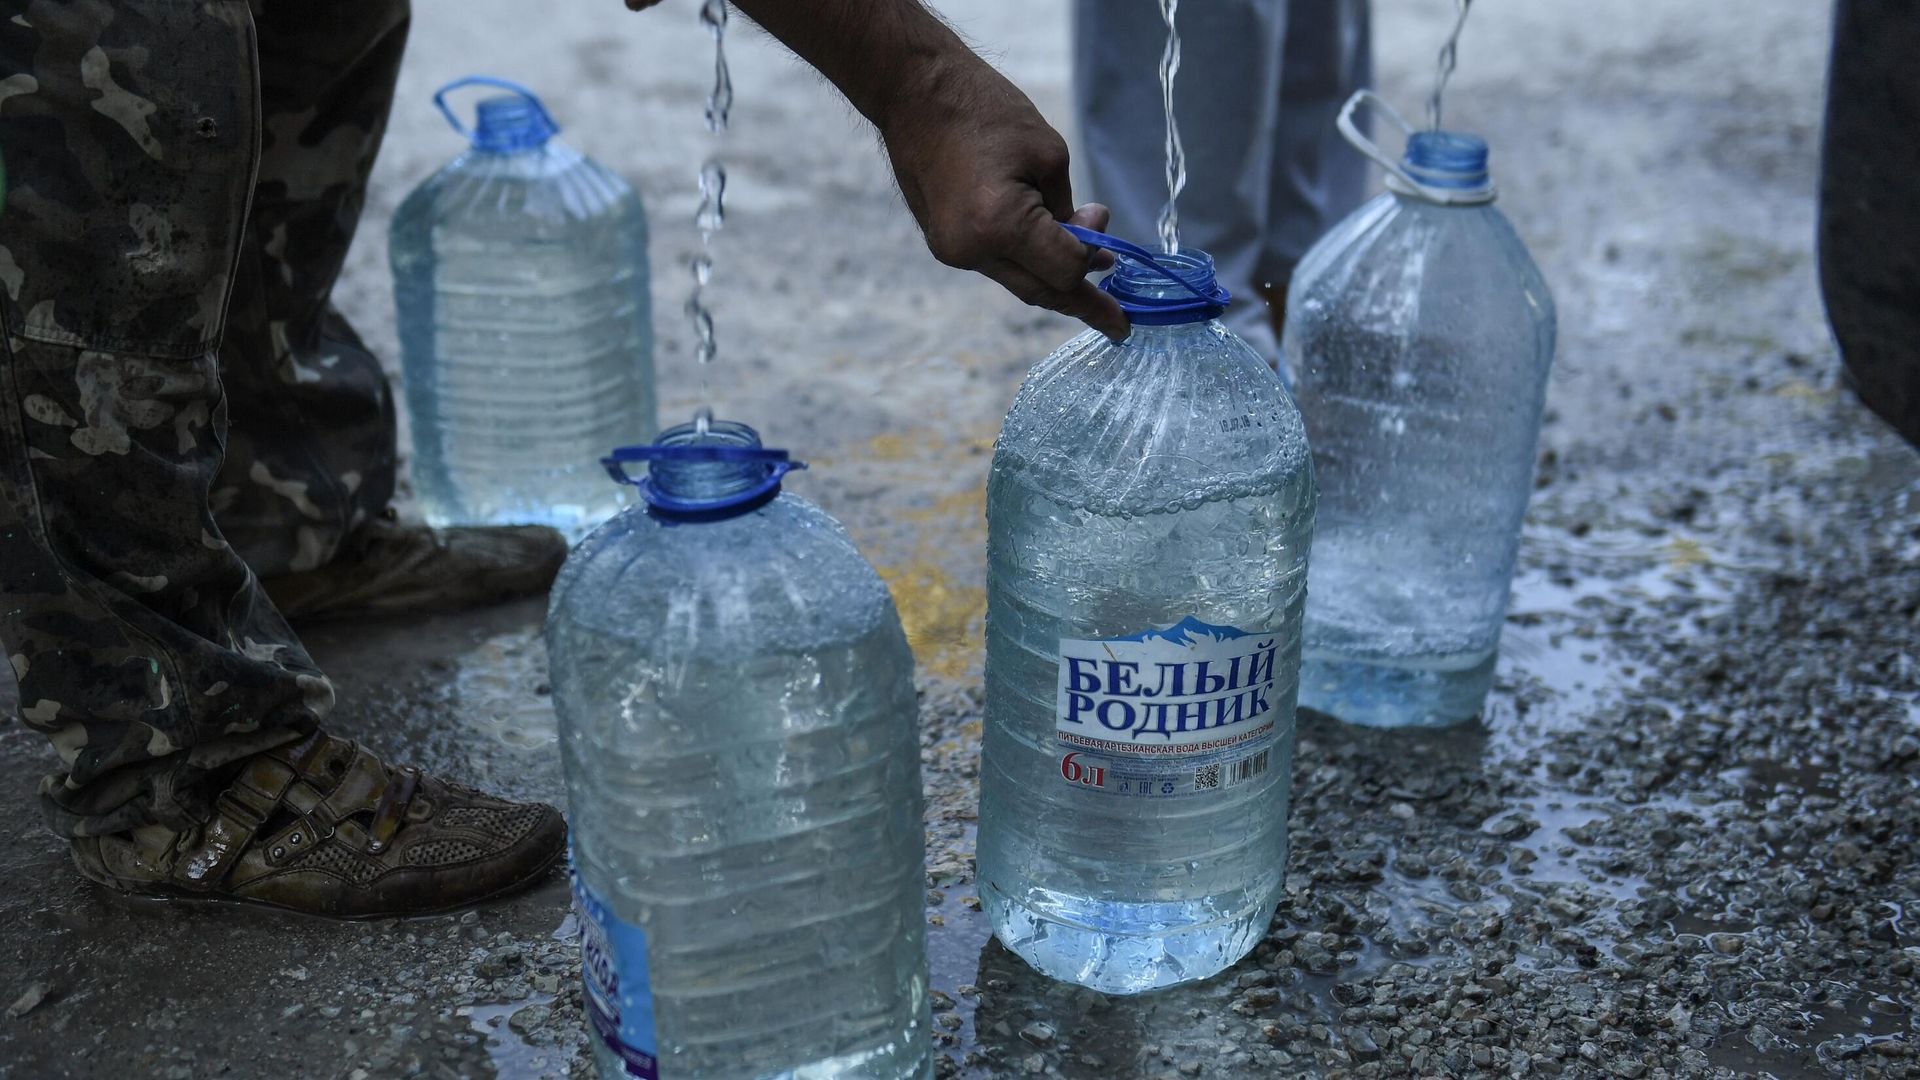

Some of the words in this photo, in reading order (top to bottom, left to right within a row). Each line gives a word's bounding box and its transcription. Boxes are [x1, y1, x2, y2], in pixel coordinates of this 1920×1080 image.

[1063, 639, 1279, 698] БЕЛЫЙ
[1058, 731, 1103, 749] ПИТЬЕВАЯ
[1104, 741, 1175, 754] АРТЕЗИАНСКАЯ
[1176, 744, 1200, 753] ВОДА
[1201, 734, 1238, 750] ВЫСШЕЙ
[1239, 720, 1274, 741] КАТЕГОРИИ
[1063, 682, 1274, 741] РОДНИК
